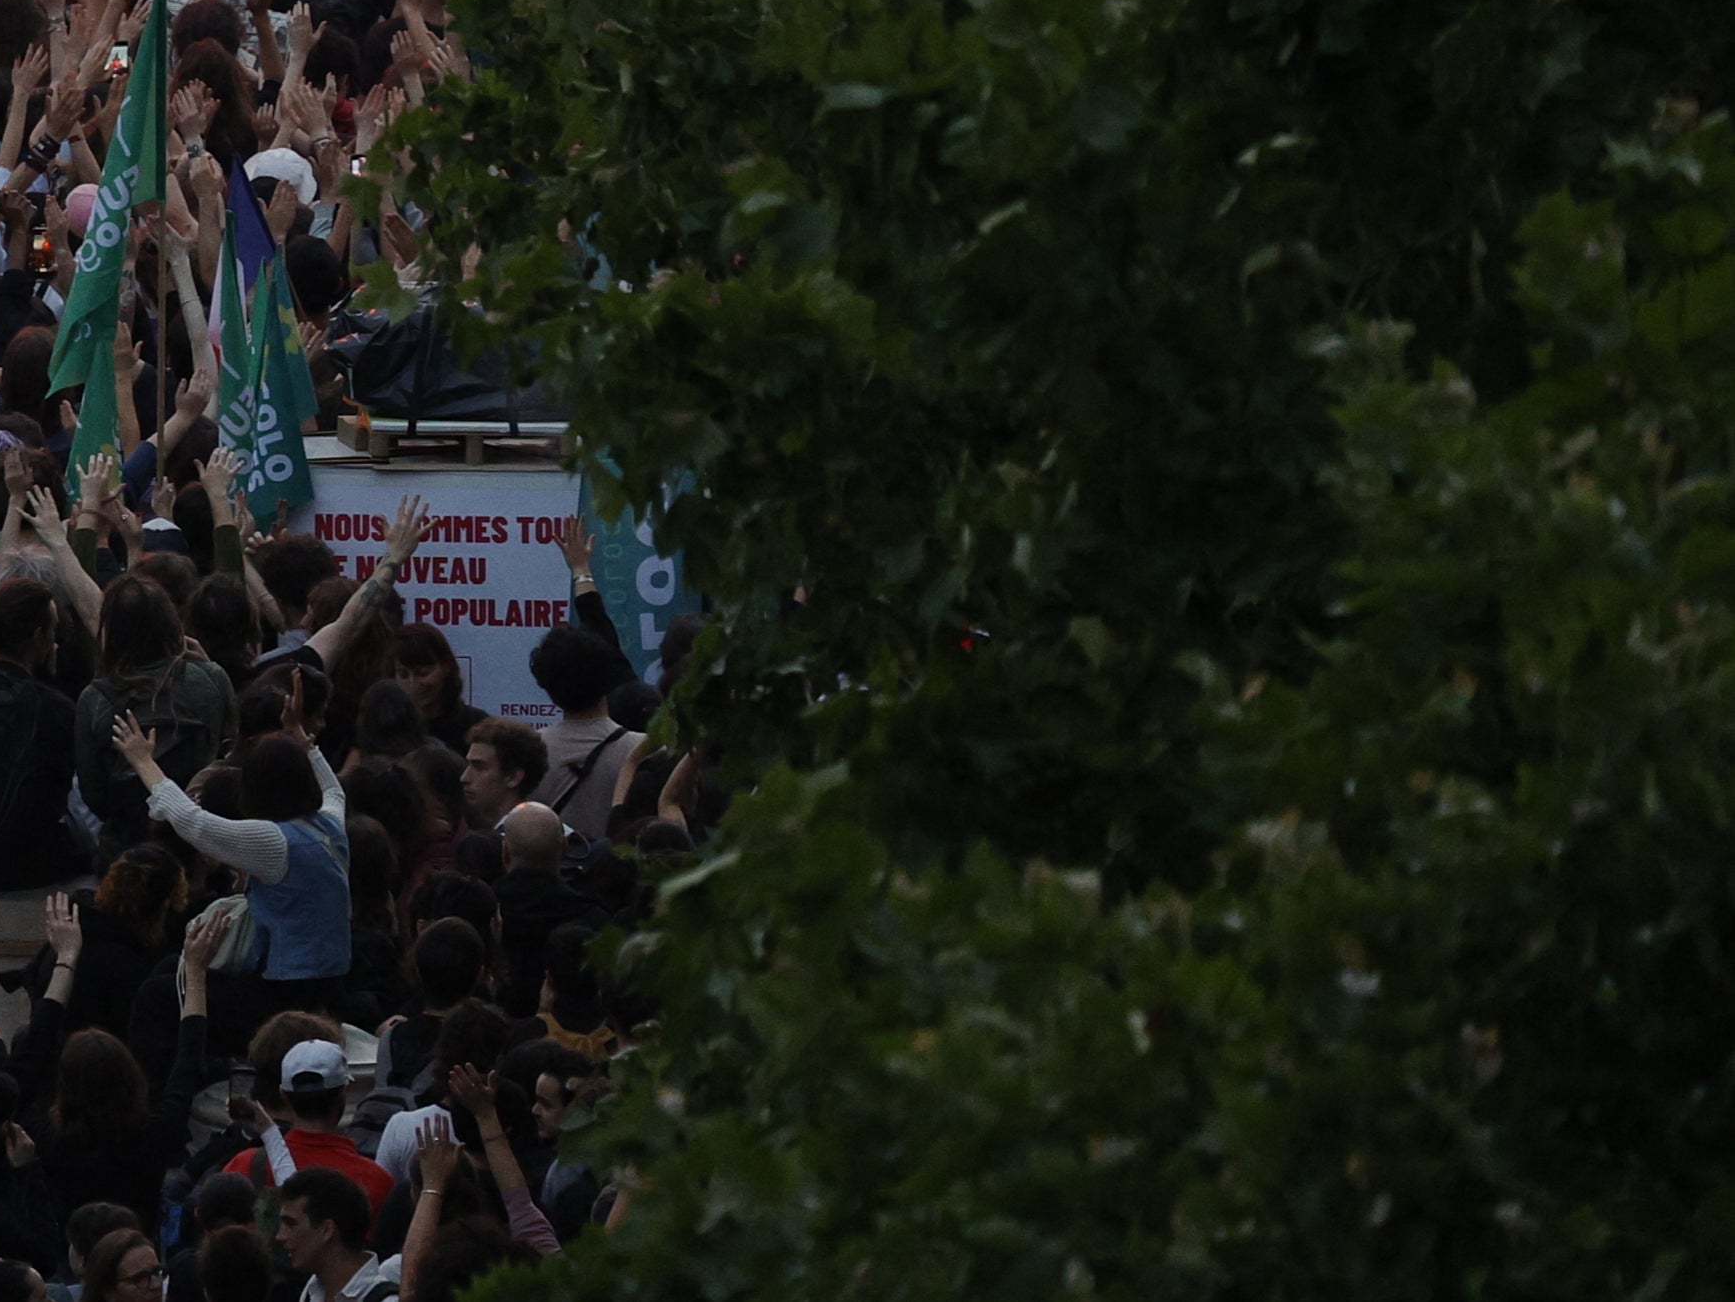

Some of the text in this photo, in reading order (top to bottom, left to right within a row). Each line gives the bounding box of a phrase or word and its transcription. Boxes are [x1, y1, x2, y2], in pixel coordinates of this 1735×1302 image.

[314, 513, 567, 544] NOUS OMMES TOU
[355, 555, 487, 585] NUVEAU
[414, 598, 569, 628] POPULAIRE
[500, 702, 563, 717] RENDEZ-
